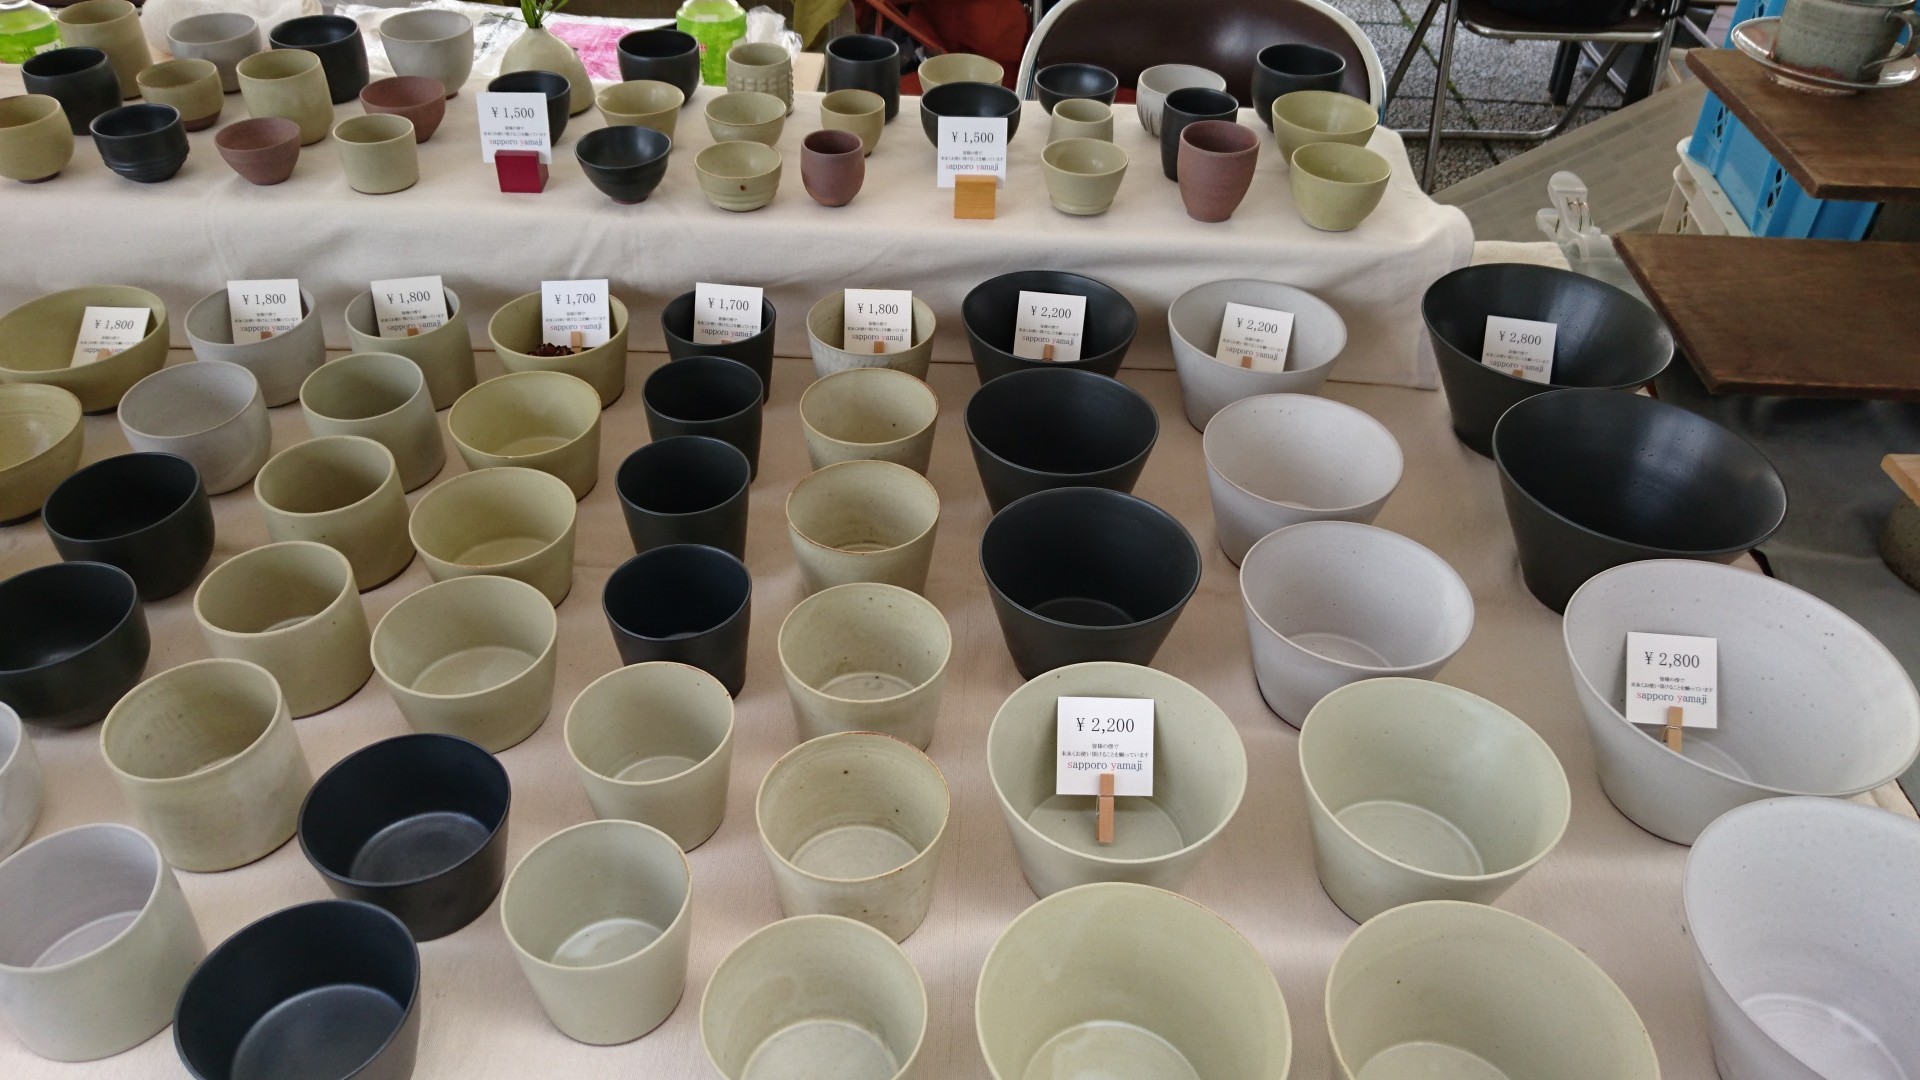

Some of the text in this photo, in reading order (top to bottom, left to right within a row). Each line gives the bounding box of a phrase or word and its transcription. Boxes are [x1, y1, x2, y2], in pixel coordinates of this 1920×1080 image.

[503, 107, 535, 119] 1,500
[489, 138, 543, 147] sapporo yamaji
[963, 132, 994, 143] 1,500
[945, 163, 974, 171] sapporo
[255, 293, 286, 306] 1,800
[399, 291, 431, 304] 1,800
[566, 293, 596, 305] 1,700
[719, 299, 749, 311] 1,700
[869, 303, 898, 315] 1,800
[1041, 307, 1071, 319] 2,200
[105, 320, 134, 330] 1,800
[240, 324, 269, 333] sapporo
[386, 320, 441, 331] sapporo yamaji
[550, 323, 602, 331] sapporo yamaji
[1247, 321, 1278, 334] 2,200
[701, 327, 729, 336] sapporo
[881, 334, 904, 342] yamaji
[1050, 337, 1075, 346] yamaji
[1509, 332, 1542, 346] 2,800
[1225, 346, 1278, 361] sapporo yamaji
[1489, 360, 1543, 373] sapporo yamaji
[1659, 653, 1700, 668] 2,800
[1636, 692, 1707, 705] sapporo yamaji
[1091, 717, 1135, 735] 2,200
[1067, 760, 1143, 772] sapporo yamaji
